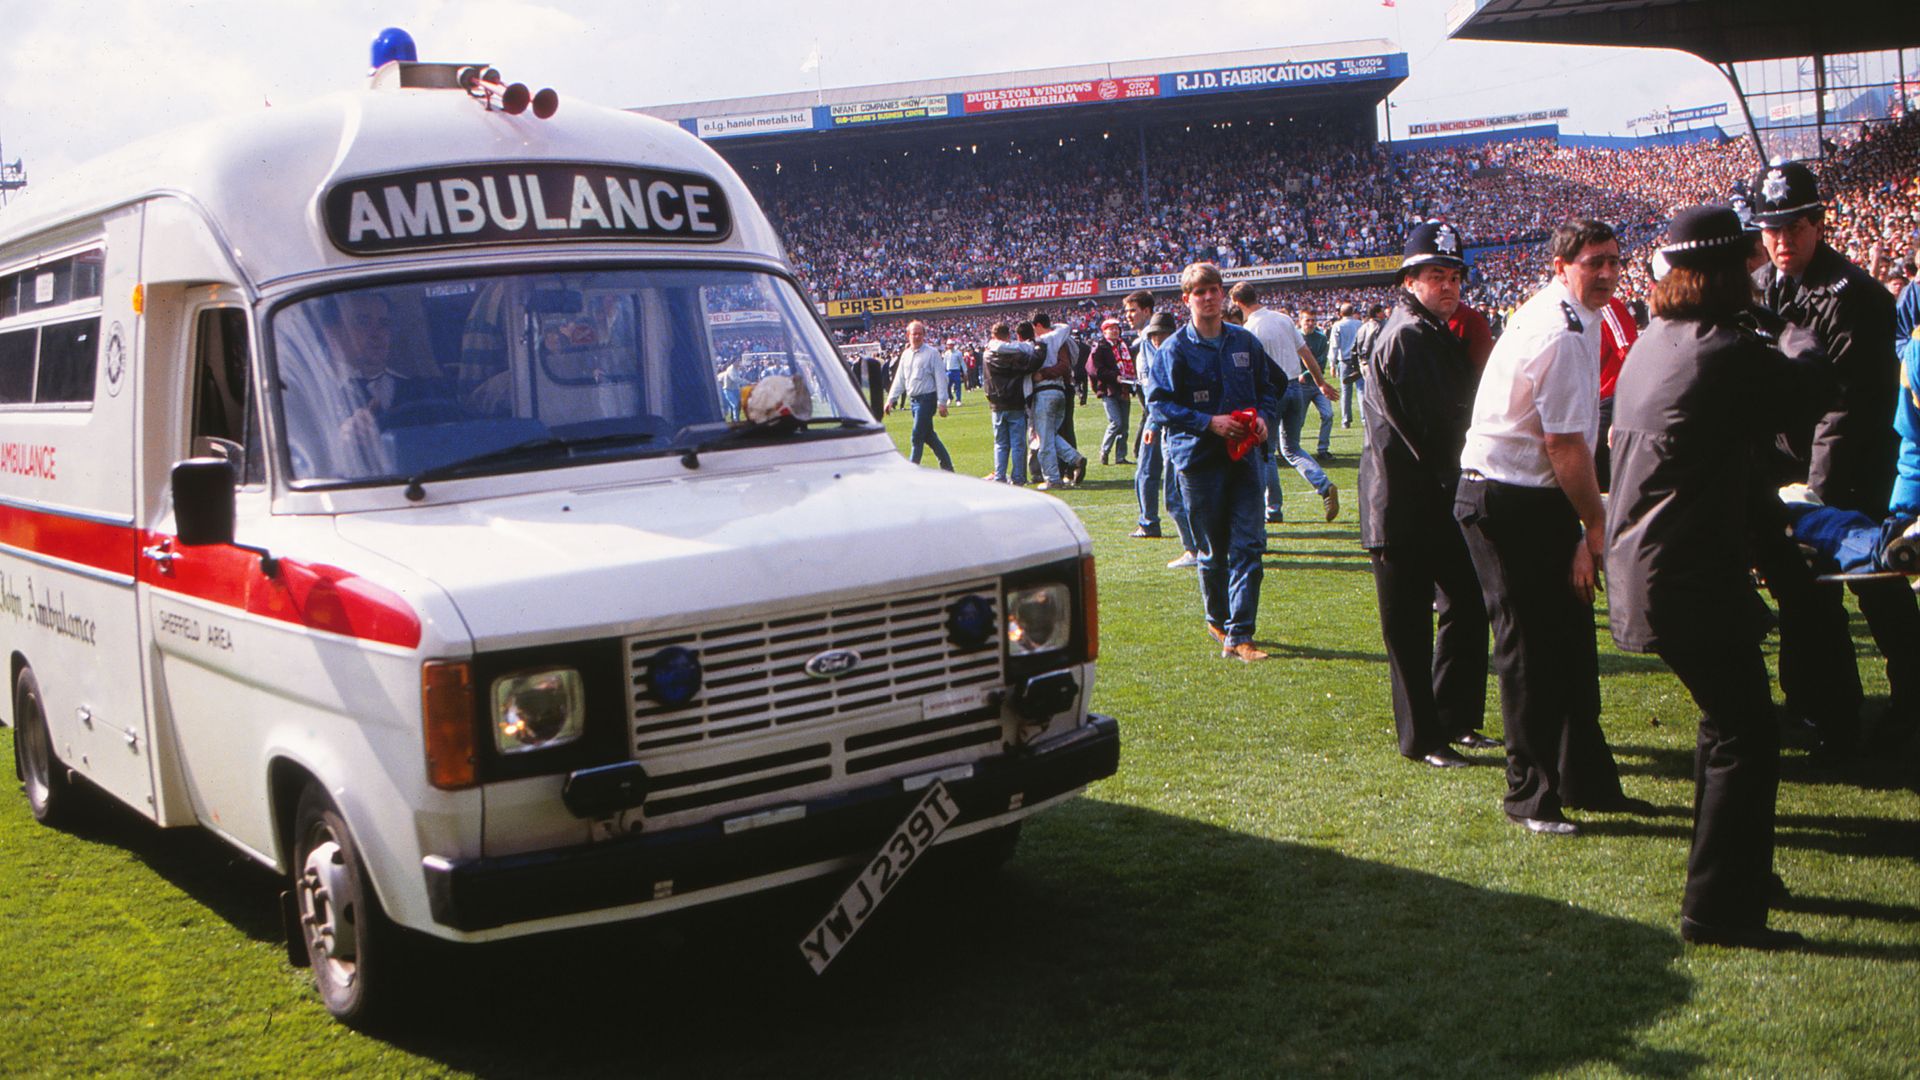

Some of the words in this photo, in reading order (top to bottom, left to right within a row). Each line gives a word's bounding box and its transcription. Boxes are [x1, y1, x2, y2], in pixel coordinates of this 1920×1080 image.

[1176, 74, 1219, 91] R.J.D.
[1222, 62, 1337, 87] FABRICATIONS
[966, 87, 1031, 104] DURLSTON
[1033, 82, 1093, 98] WINDOWS
[983, 100, 999, 111] OF
[1001, 93, 1078, 110] ROTHERHAM
[832, 104, 858, 114] INFANT
[860, 101, 900, 112] COMPANIES
[757, 115, 789, 126] metals
[1440, 118, 1485, 132] NICHOLSON
[348, 174, 718, 242] AMBULANCE
[1267, 265, 1300, 276] TIMBER
[1316, 261, 1346, 272] Henry
[1348, 259, 1370, 270] Boot
[1110, 278, 1136, 289] ERIC
[1140, 274, 1177, 287] STEAD
[987, 288, 1017, 302] SUGG
[1020, 284, 1058, 299] SPORT
[1061, 281, 1092, 295] SUGG
[840, 297, 904, 314] PRESTO
[1, 443, 56, 480] AMBULANCE
[27, 576, 96, 647] Ambulance
[160, 610, 201, 642] SHEFFIELD
[207, 624, 234, 653] AREA
